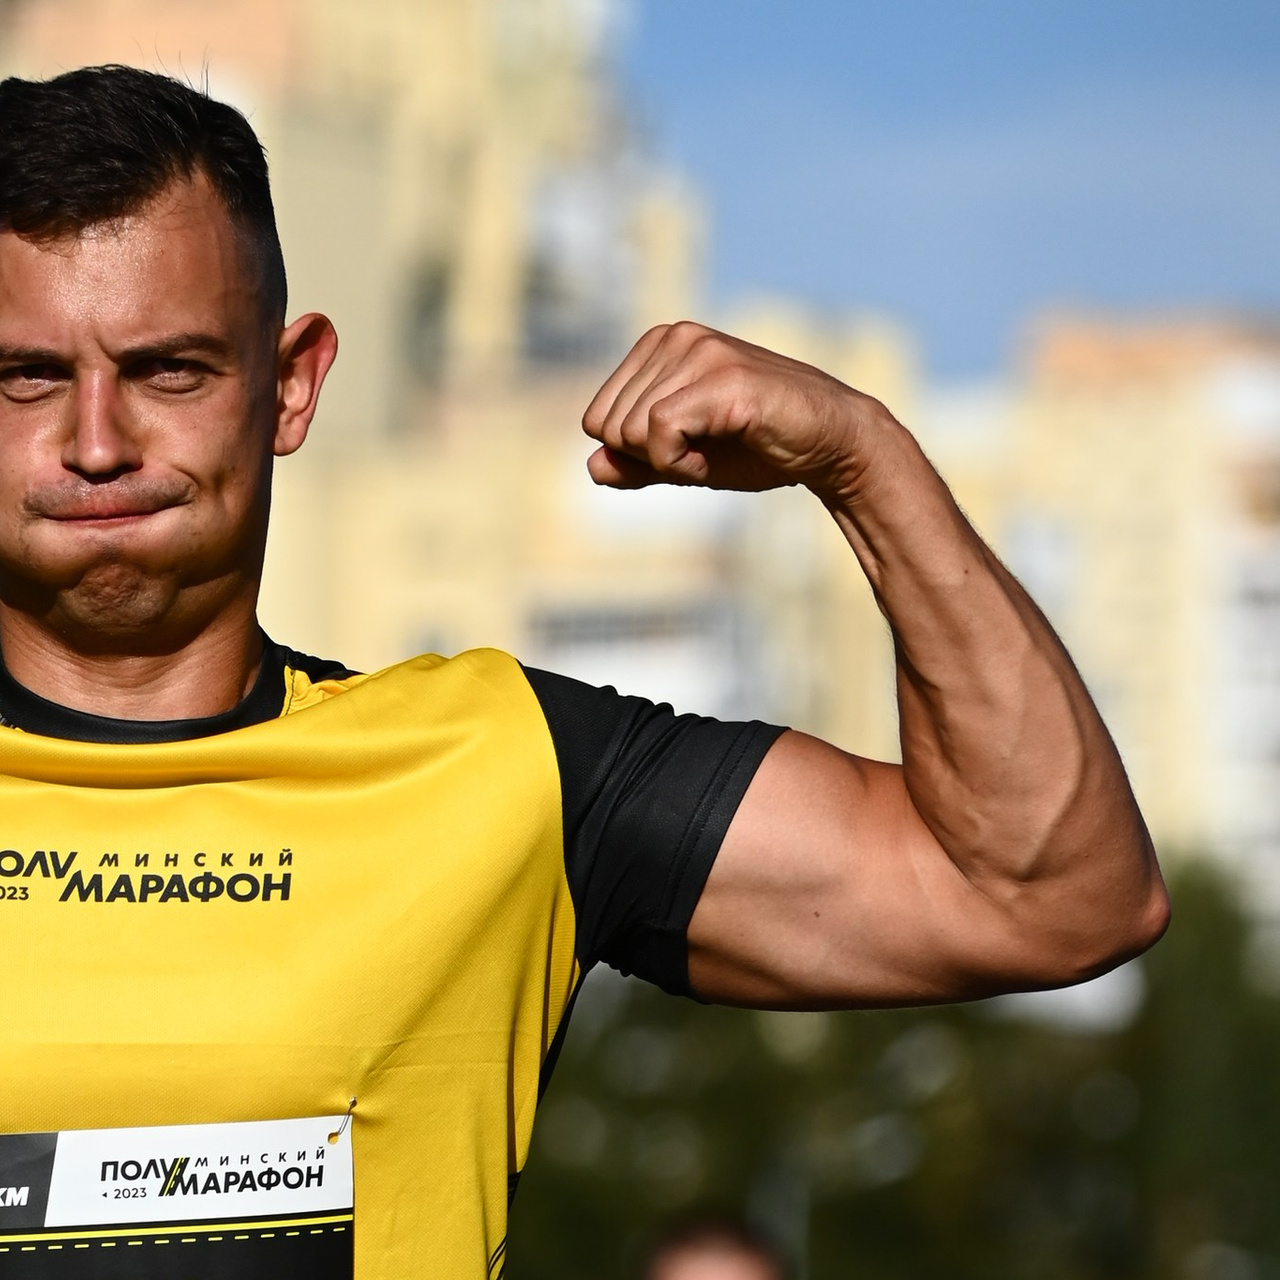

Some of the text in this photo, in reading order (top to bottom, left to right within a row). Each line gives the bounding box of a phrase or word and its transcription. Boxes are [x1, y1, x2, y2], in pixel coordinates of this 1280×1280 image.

[98, 848, 294, 868] МИНСКИЙ
[59, 870, 293, 903] МАРАФОН
[194, 1146, 326, 1168] МИНСКИЙ
[100, 1157, 190, 1192] ПОЛУ
[161, 1165, 325, 1196] МАРАФОН
[113, 1187, 148, 1199] 2023
